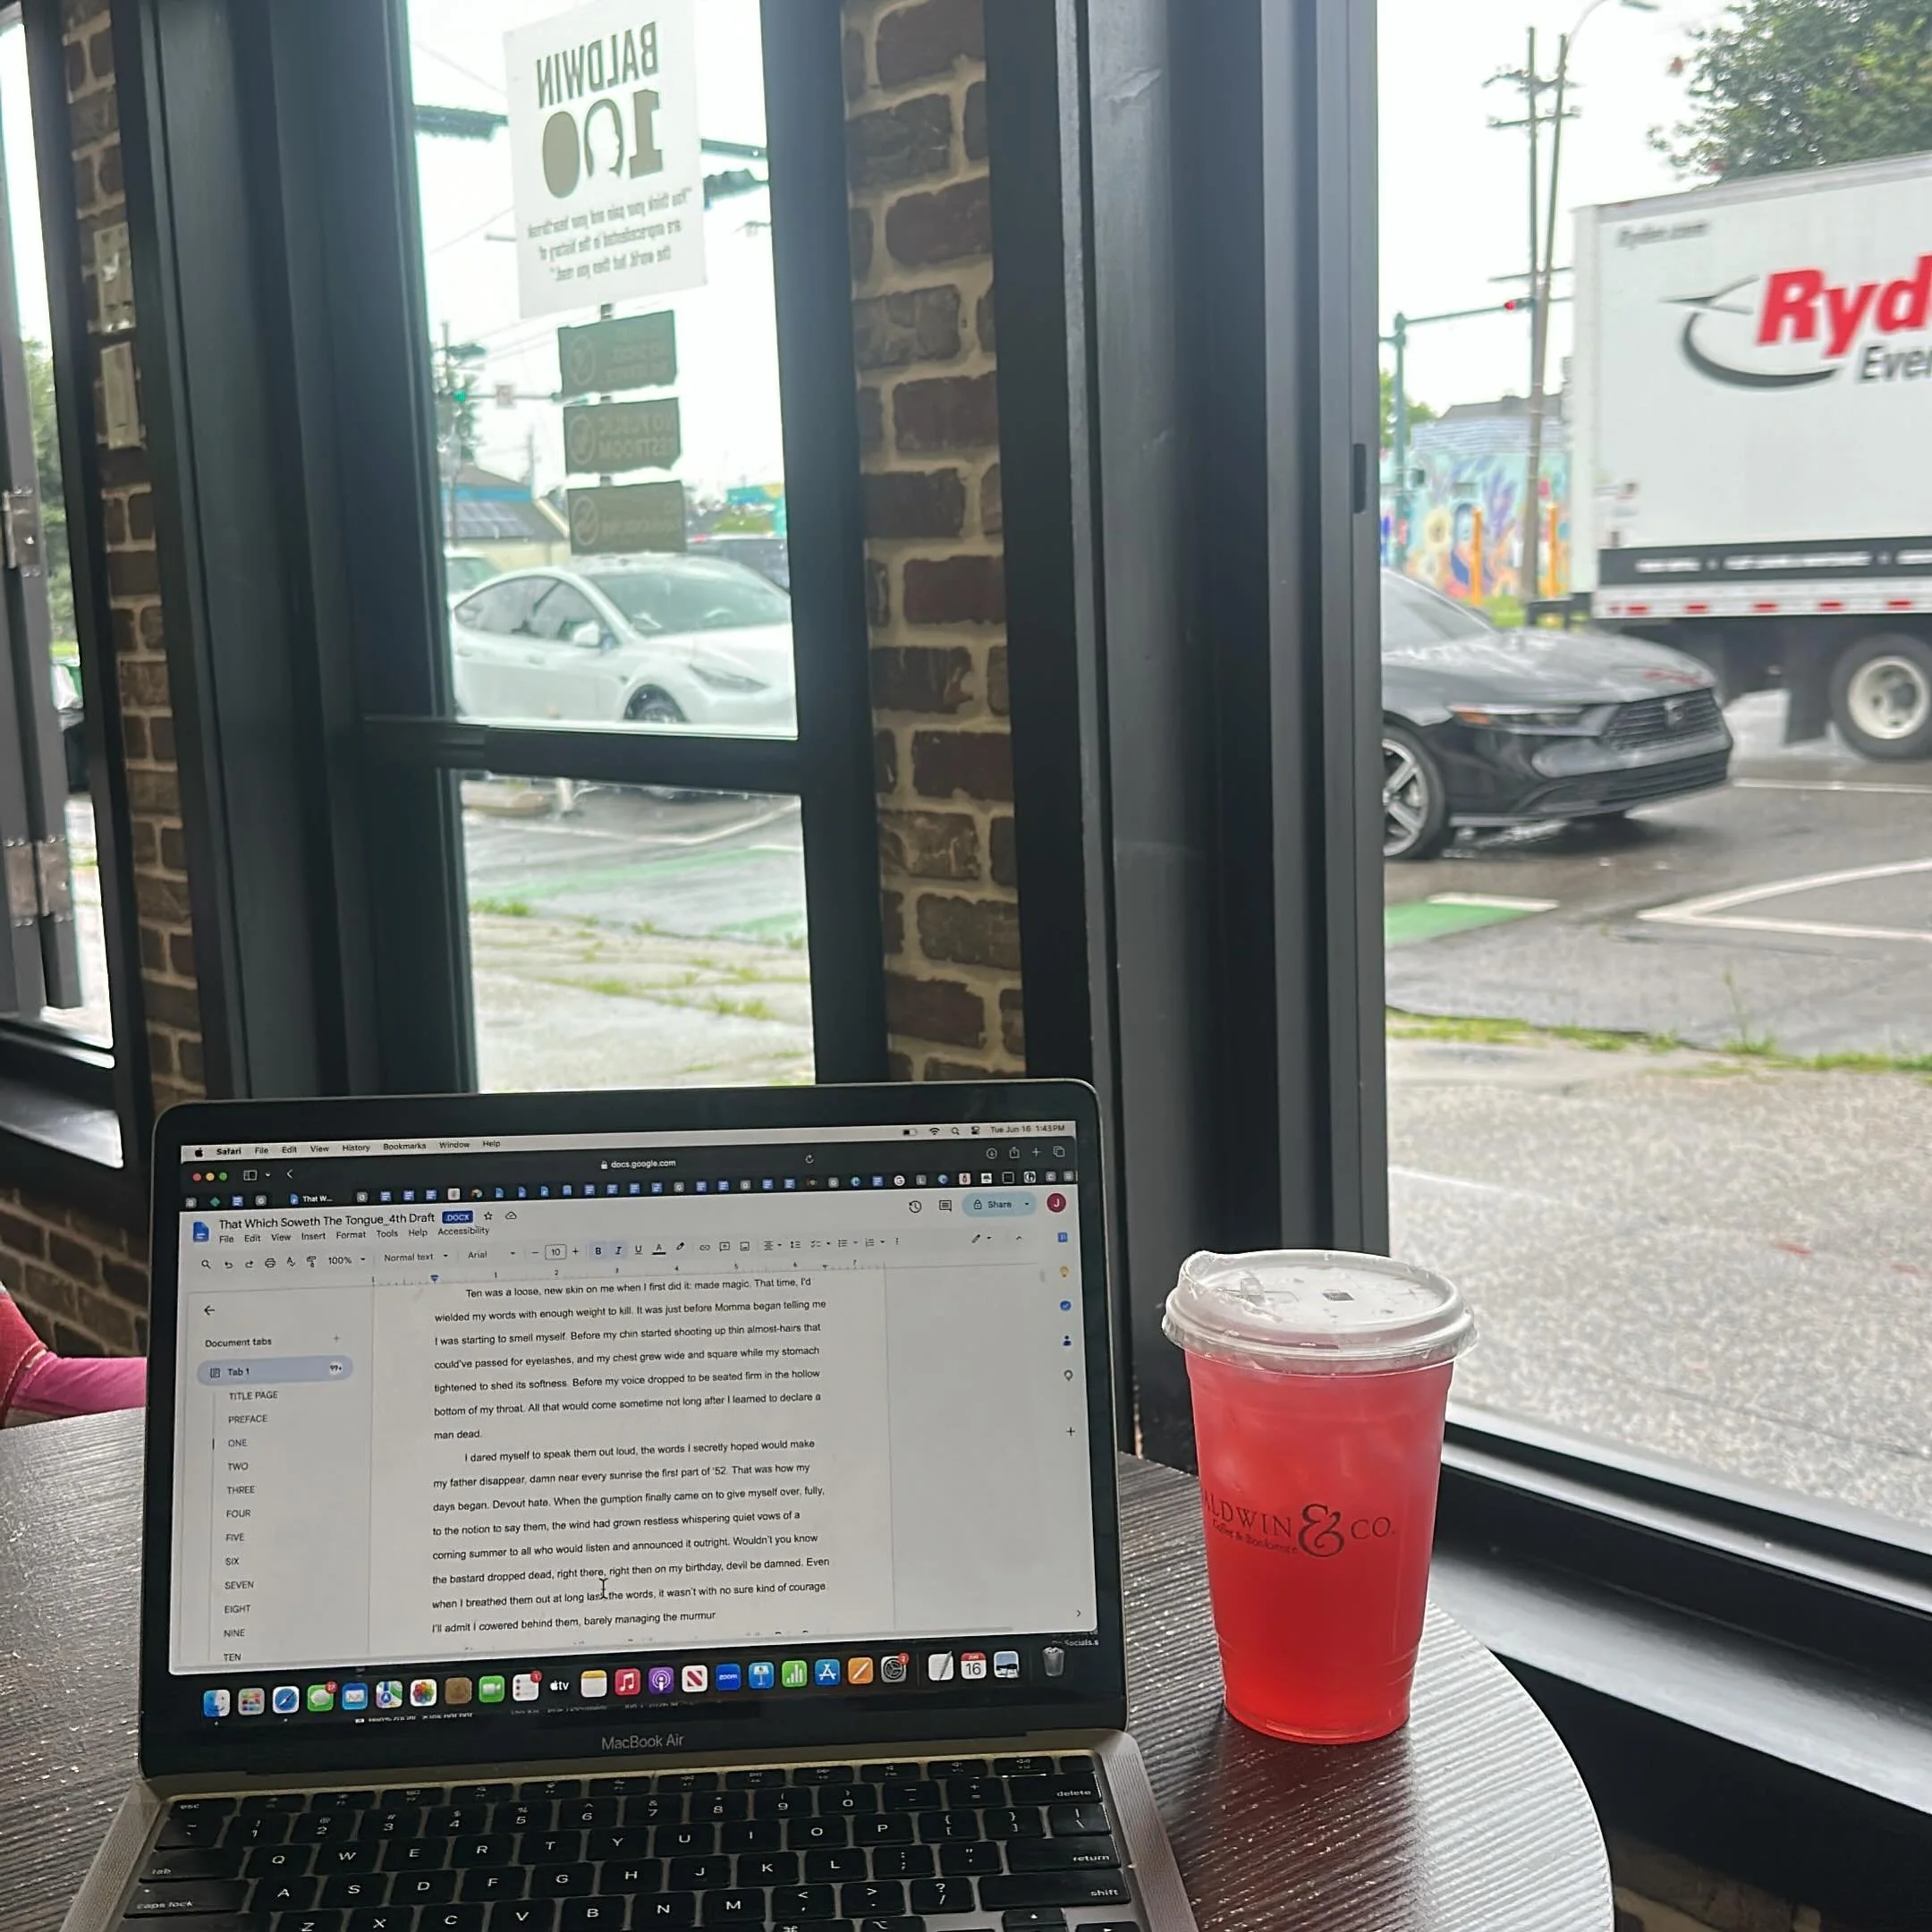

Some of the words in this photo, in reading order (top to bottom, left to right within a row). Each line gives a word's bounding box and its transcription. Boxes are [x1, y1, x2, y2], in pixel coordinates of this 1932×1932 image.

[216, 1148, 242, 1156] Safari
[282, 1146, 297, 1154] Edit
[310, 1145, 329, 1153] View
[343, 1144, 370, 1153] History
[383, 1141, 427, 1151] Bookmarks
[439, 1140, 470, 1149] Window
[482, 1140, 501, 1149] Help
[611, 1159, 676, 1169] docs.google.com
[302, 1195, 318, 1203] That
[987, 1200, 1013, 1208] Share
[1054, 1198, 1060, 1208] J
[219, 1219, 242, 1229] That
[244, 1217, 278, 1228] Which
[280, 1216, 320, 1227] Soweth
[323, 1216, 343, 1225] The
[345, 1214, 407, 1227] Tongue_4th
[409, 1213, 436, 1223] Draft
[219, 1235, 234, 1244] File
[244, 1234, 261, 1242] Edit
[271, 1233, 292, 1241] View
[301, 1232, 326, 1241] Insert
[336, 1231, 366, 1240] Format
[377, 1229, 399, 1238] Tools
[408, 1229, 428, 1238] Help
[437, 1225, 490, 1236] Accessibility
[328, 1257, 352, 1265] 100%
[384, 1253, 415, 1262] Normal
[417, 1253, 434, 1261] text
[468, 1250, 487, 1259] Arial
[551, 1249, 561, 1257] 10
[466, 1290, 482, 1298] Ten
[565, 1286, 583, 1294] skin
[617, 1284, 641, 1292] when
[644, 1283, 647, 1292] I
[649, 1283, 665, 1291] first
[668, 1282, 681, 1291] did
[695, 1281, 719, 1289] made
[723, 1280, 751, 1290] magic.
[754, 1279, 775, 1287] That
[776, 1279, 798, 1287] time,
[801, 1277, 811, 1285] I'd
[435, 1313, 470, 1322] wielded
[472, 1314, 486, 1322] my
[488, 1311, 516, 1319] words
[519, 1310, 537, 1318] with
[540, 1309, 573, 1319] enough
[576, 1308, 606, 1318] weight
[619, 1307, 633, 1315] kill.
[637, 1306, 642, 1315] It
[665, 1305, 682, 1316] just
[683, 1304, 712, 1313] before
[716, 1303, 750, 1311] Momma
[753, 1302, 781, 1312] began
[784, 1301, 809, 1310] telling
[205, 1338, 250, 1348] Document
[252, 1337, 272, 1346] tabs
[227, 1368, 243, 1377] Tab
[229, 1392, 252, 1401] TITLE
[255, 1390, 278, 1399] PAGE
[228, 1414, 268, 1424] PREFACE
[456, 1429, 482, 1438] dead.
[228, 1438, 248, 1448] ONE
[228, 1462, 249, 1471] TWO
[227, 1485, 256, 1495] THREE
[225, 1508, 251, 1519] FOUR
[1298, 1504, 1344, 1557] &
[1351, 1517, 1395, 1540] CO.
[225, 1532, 245, 1542] FIVE
[225, 1556, 240, 1566] SIX
[225, 1580, 254, 1590] SEVEN
[224, 1604, 250, 1614] EIGHT
[432, 1624, 442, 1632] I'll
[445, 1623, 470, 1631] admit
[473, 1622, 476, 1631] I
[479, 1621, 518, 1630] cowered
[521, 1619, 552, 1628] behind
[555, 1618, 580, 1627] them,
[584, 1616, 612, 1626] barely
[615, 1614, 660, 1624] managing
[663, 1613, 677, 1622] the
[224, 1628, 245, 1638] NINE
[223, 1652, 242, 1662] TEN
[965, 1662, 981, 1675] 16
[601, 1734, 663, 1750] MacBook
[665, 1733, 685, 1747] Air
[152, 1867, 172, 1875] tab
